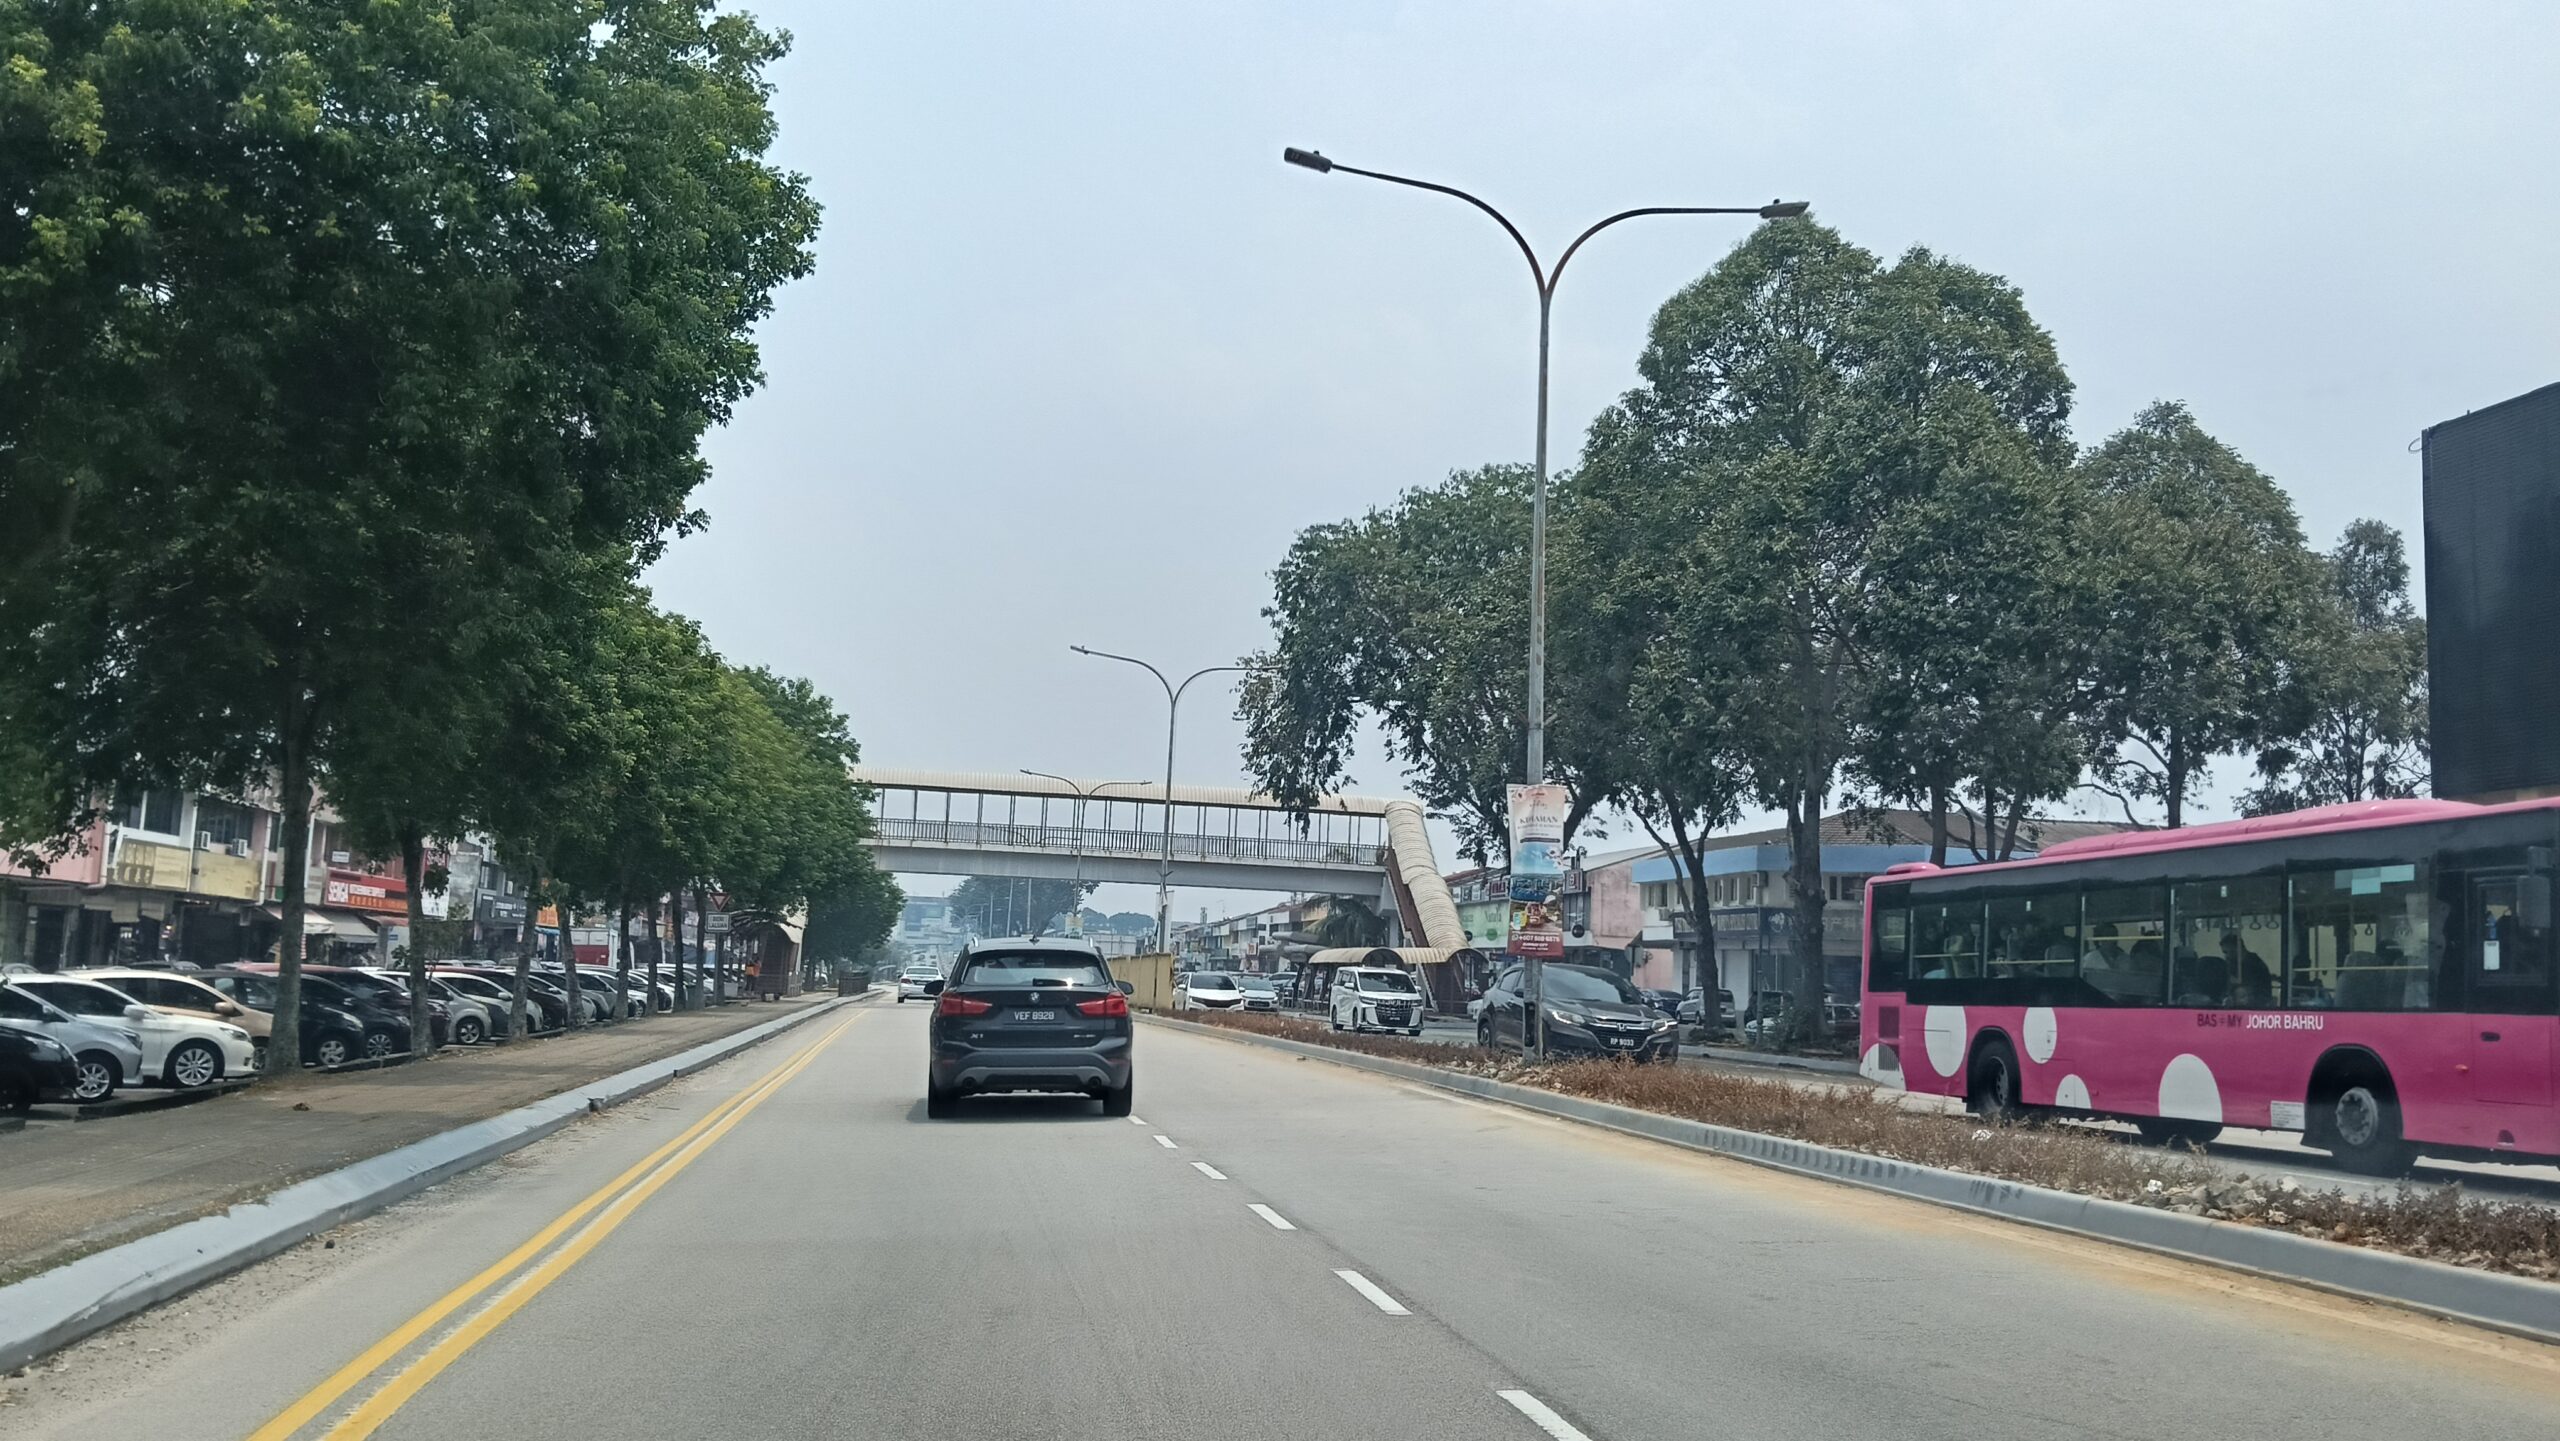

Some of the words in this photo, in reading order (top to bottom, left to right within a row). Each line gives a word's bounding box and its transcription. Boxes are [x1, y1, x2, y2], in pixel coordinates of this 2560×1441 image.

[1014, 1011, 1030, 1020] VEF
[1032, 1011, 1055, 1020] 8928
[2197, 1013, 2217, 1028] BAS
[2246, 1014, 2281, 1029] JOHOR
[2284, 1015, 2324, 1030] BAHRU
